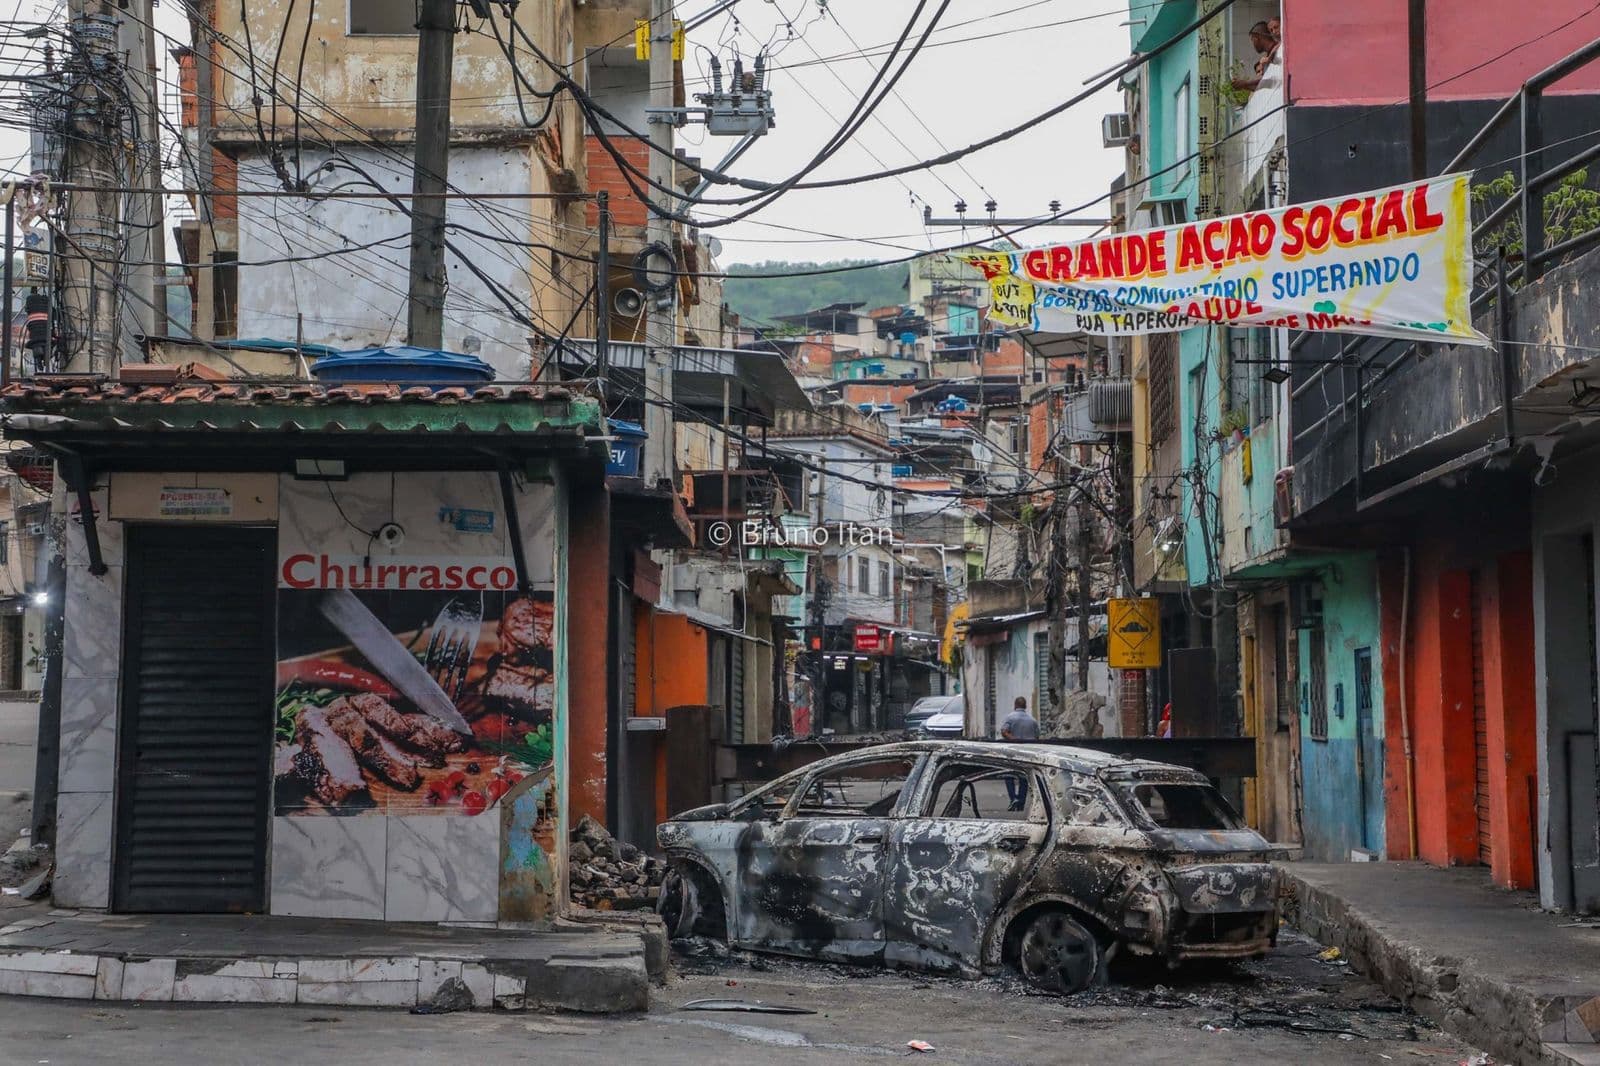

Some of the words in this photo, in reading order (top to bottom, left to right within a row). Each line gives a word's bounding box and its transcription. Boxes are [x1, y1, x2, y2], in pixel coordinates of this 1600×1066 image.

[1024, 229, 1168, 283] GRANDE
[1174, 211, 1277, 270] AÇÃO
[1280, 182, 1444, 258] SOCIAL
[1114, 275, 1258, 306] COMUNTÁRIO
[1271, 253, 1419, 300] SUPERANDO
[282, 553, 516, 590] Churrasco
